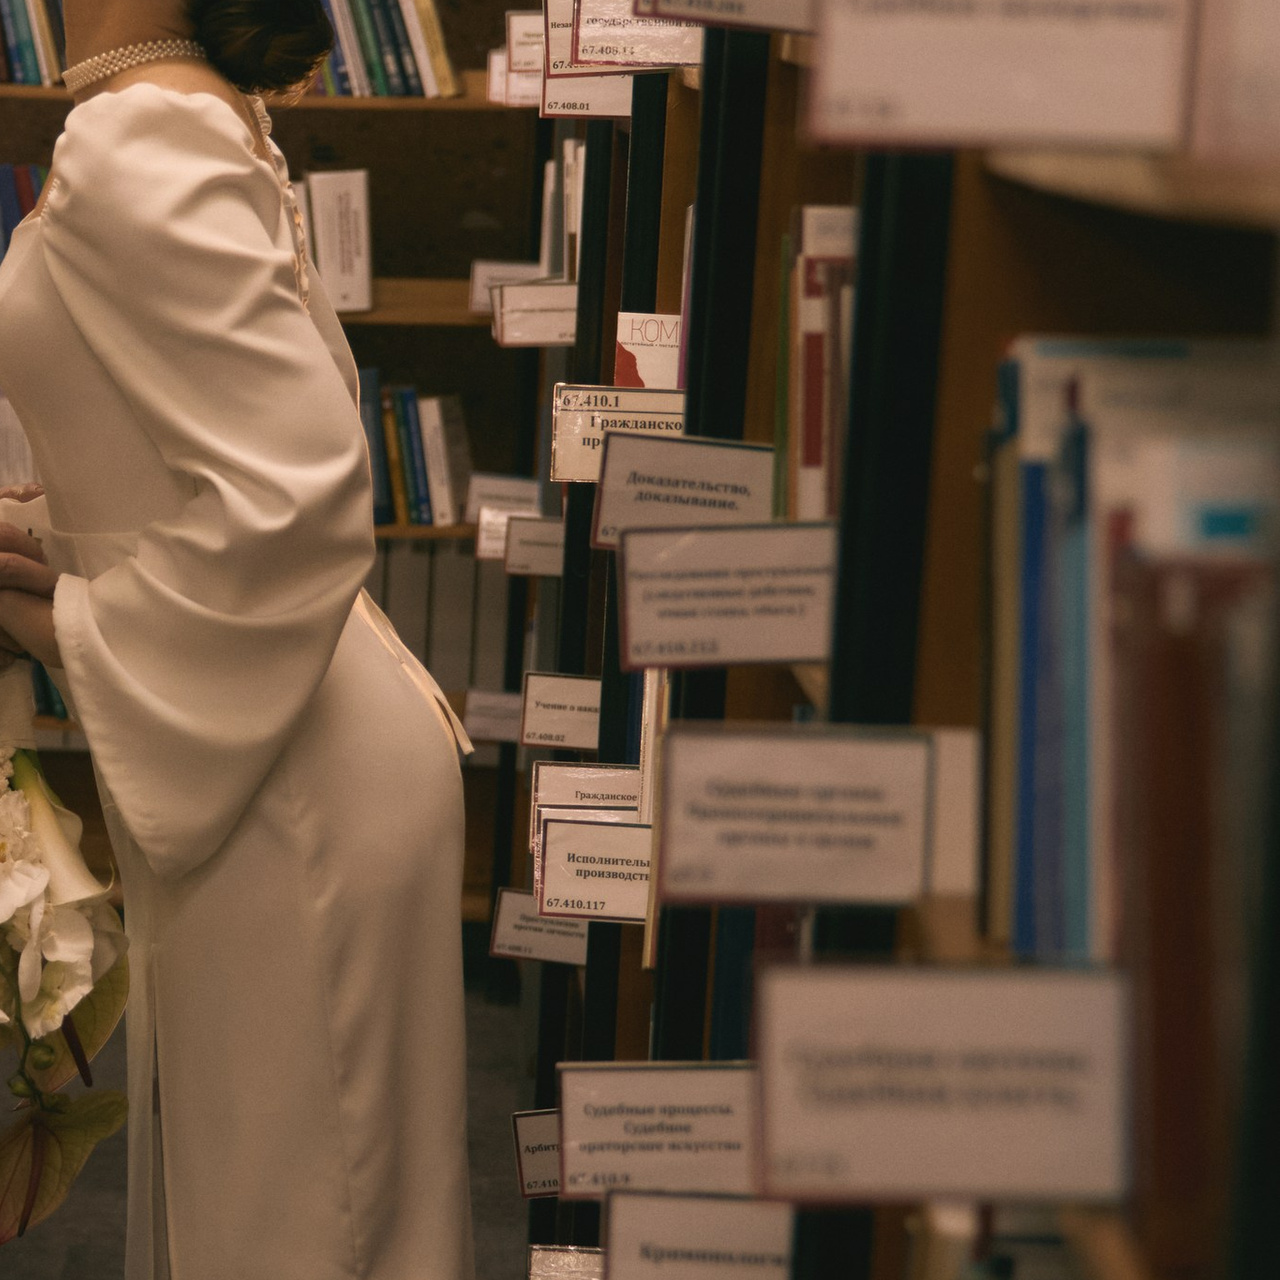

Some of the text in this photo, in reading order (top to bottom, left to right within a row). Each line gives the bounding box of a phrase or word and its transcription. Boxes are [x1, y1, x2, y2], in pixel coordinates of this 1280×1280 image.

[547, 101, 591, 111] 67.408.01
[563, 394, 620, 408] 67.410.1
[590, 414, 684, 431] Гражданско
[626, 470, 751, 497] Доказательство,
[634, 489, 739, 510] доказывание.
[534, 700, 568, 712] Учение
[525, 731, 566, 743] 67.408.02
[575, 789, 638, 802] Гражданское
[546, 896, 606, 911] 67.410.117
[583, 1102, 656, 1118] Судебные
